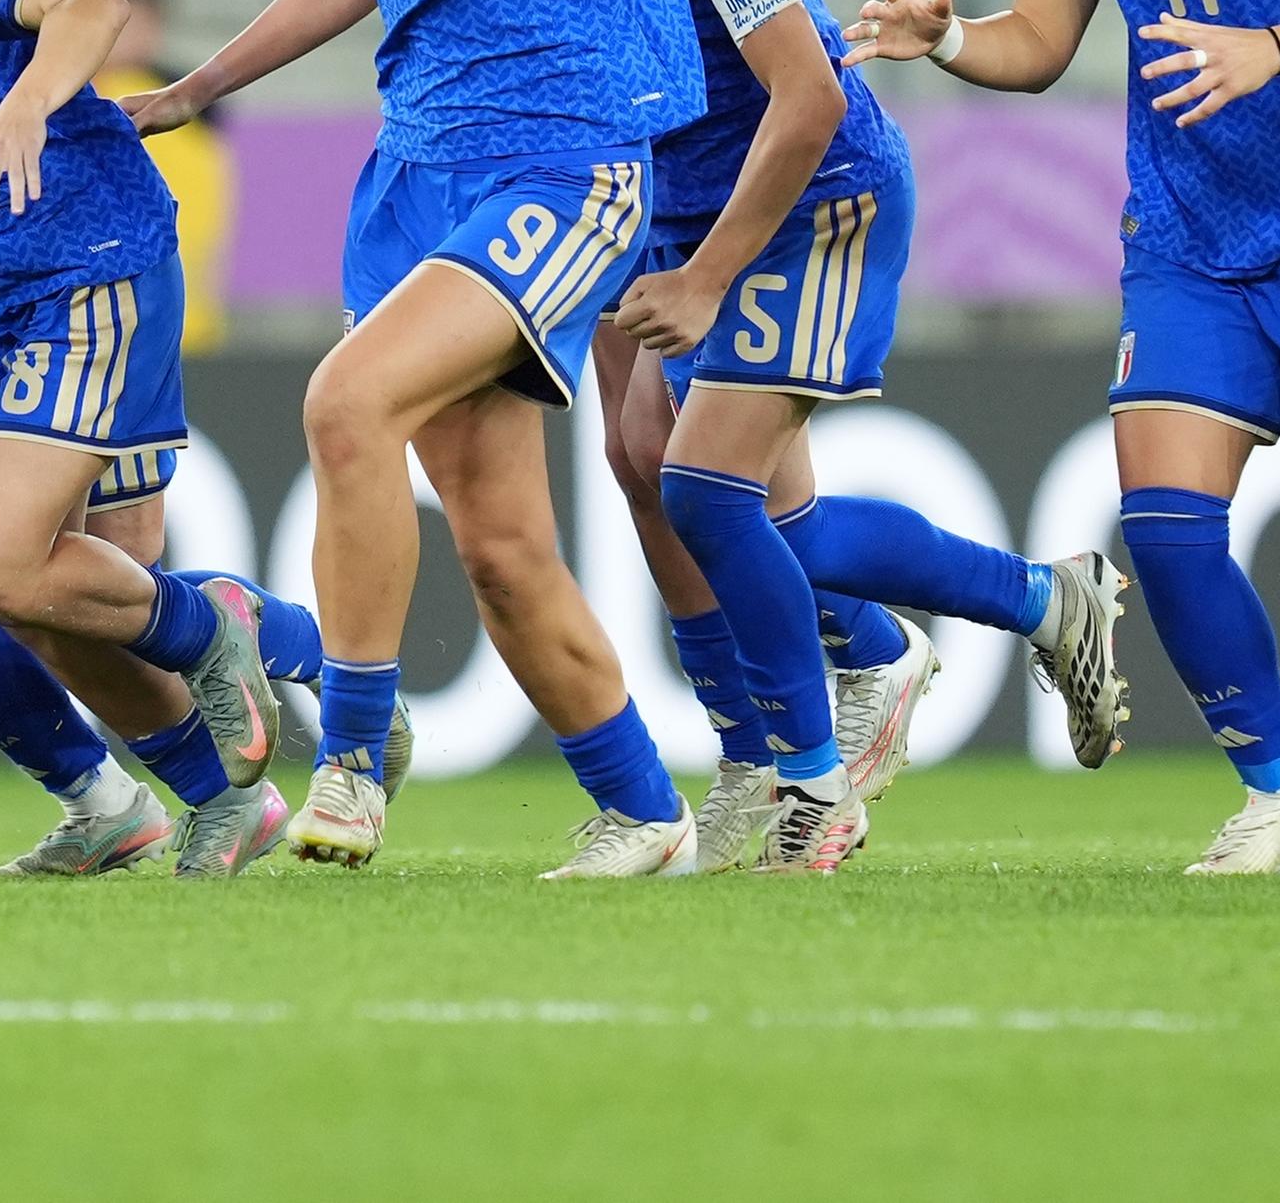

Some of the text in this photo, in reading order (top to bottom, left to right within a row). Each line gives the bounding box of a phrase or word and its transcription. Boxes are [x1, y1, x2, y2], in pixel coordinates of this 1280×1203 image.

[732, 12, 752, 30] the
[487, 203, 557, 276] 9
[734, 274, 788, 364] 5
